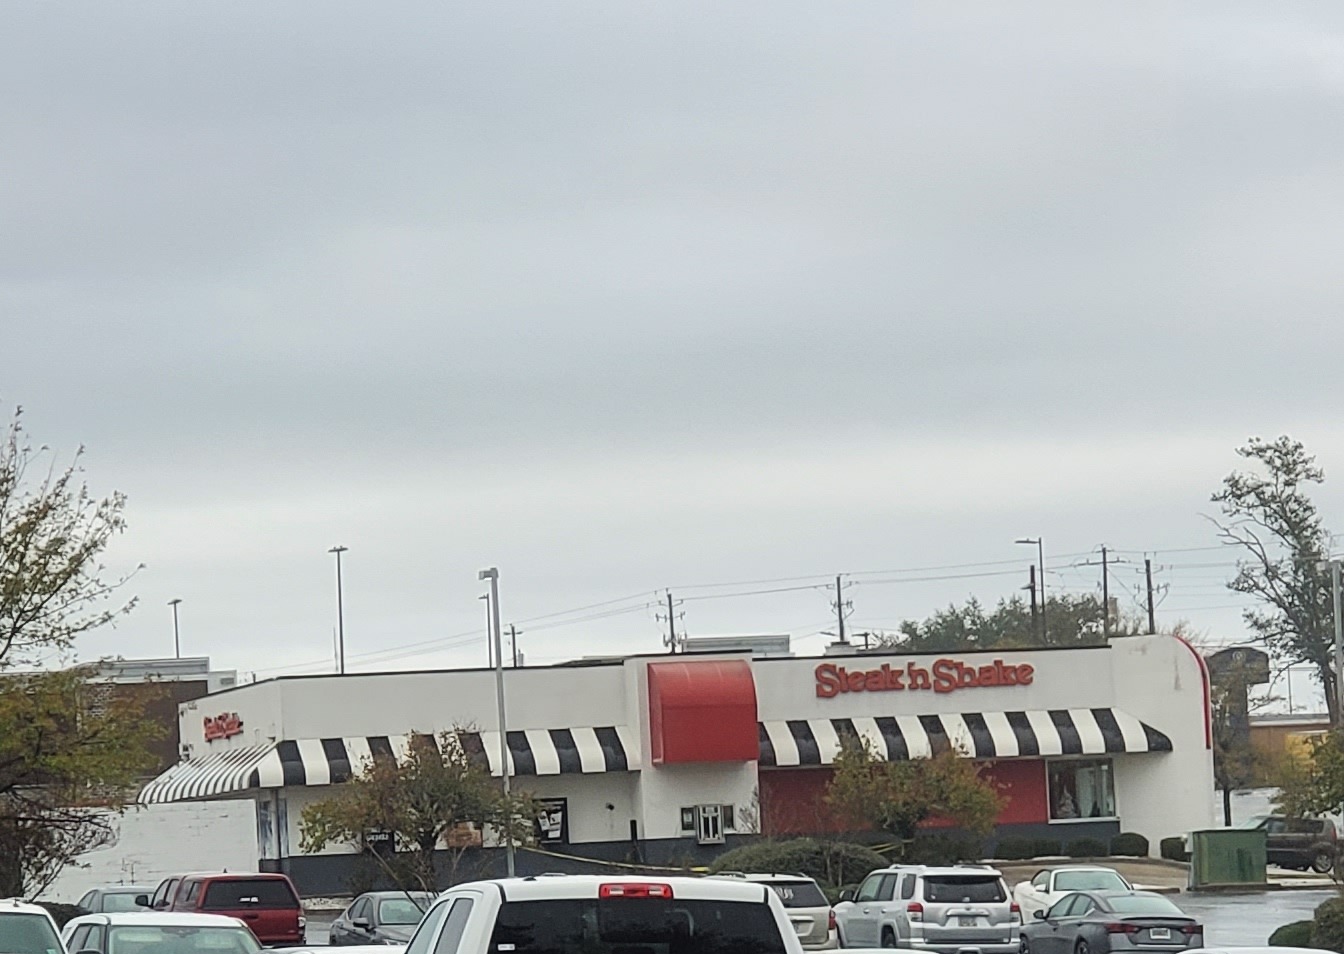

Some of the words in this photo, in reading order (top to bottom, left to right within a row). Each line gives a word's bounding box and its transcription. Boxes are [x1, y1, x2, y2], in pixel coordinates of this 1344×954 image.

[815, 663, 905, 698] Steak
[907, 661, 932, 690] 'n
[932, 658, 1034, 693] Shake
